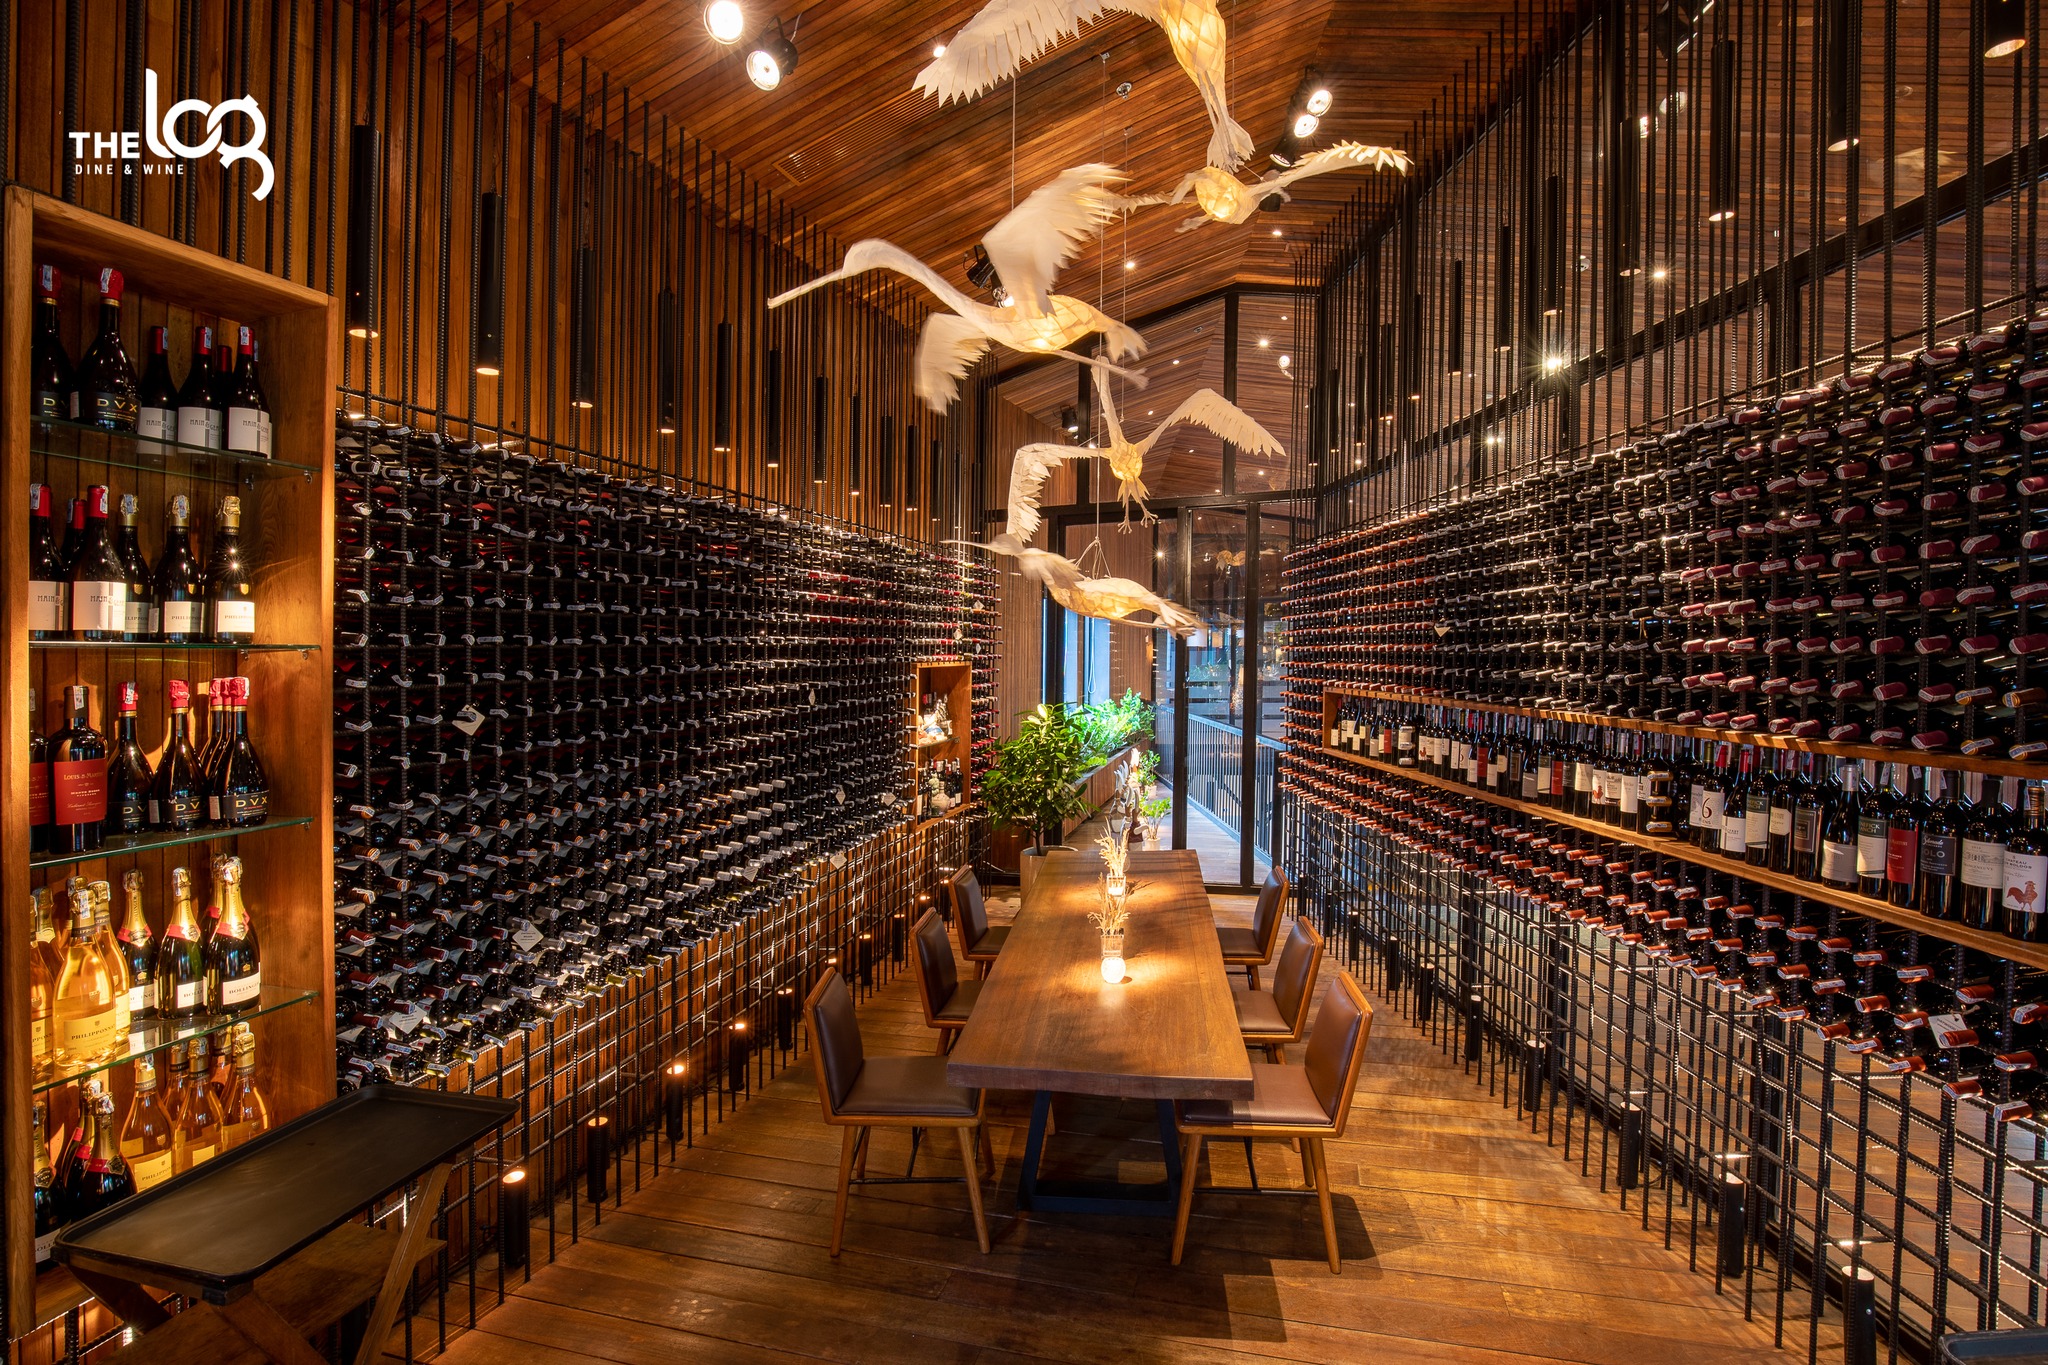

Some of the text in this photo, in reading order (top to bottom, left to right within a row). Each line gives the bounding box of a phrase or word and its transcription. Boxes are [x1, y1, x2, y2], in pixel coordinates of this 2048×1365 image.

[97, 398, 138, 413] DVX
[235, 796, 268, 808] DVX
[1701, 797, 1713, 819] 6
